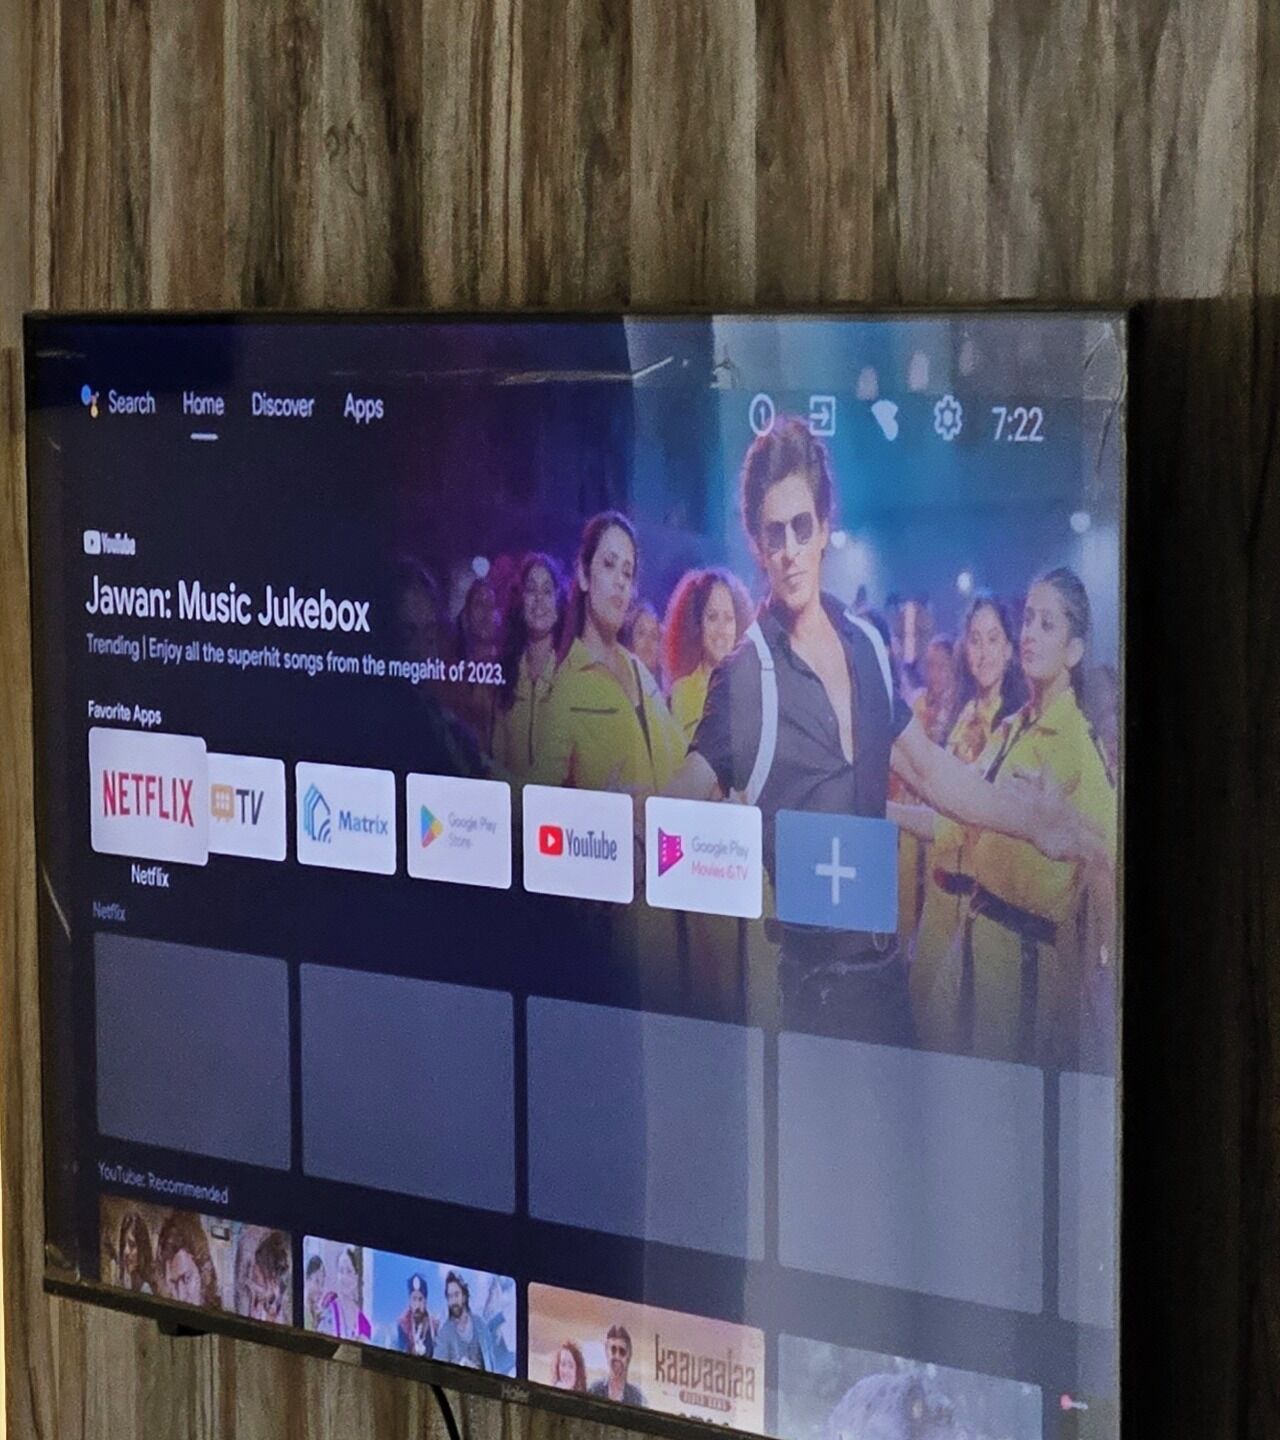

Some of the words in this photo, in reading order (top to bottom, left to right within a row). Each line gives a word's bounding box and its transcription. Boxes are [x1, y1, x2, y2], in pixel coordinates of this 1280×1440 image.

[108, 389, 156, 415] Search
[183, 391, 225, 416] Home
[251, 391, 315, 417] Discover
[343, 392, 384, 424] Apps
[991, 406, 1045, 442] 7:22
[85, 574, 172, 619] Jawan:
[177, 579, 252, 625] Music
[257, 584, 371, 632] Jukebox
[86, 632, 139, 662] Trending
[148, 637, 183, 665] Enjoy
[184, 641, 200, 661] all
[202, 641, 225, 663] the
[227, 645, 281, 671] superhit
[283, 651, 324, 677] songs
[326, 650, 360, 674] from
[361, 653, 386, 677] the
[389, 657, 446, 685] megahit
[448, 659, 465, 682] of
[467, 661, 507, 685] 2023.
[87, 700, 132, 721] Favorite
[133, 703, 162, 728] Apps
[102, 768, 195, 828] NETFLIX
[235, 787, 265, 826] TV
[338, 809, 389, 836] Matrix
[447, 811, 478, 834] Google
[480, 815, 497, 835] Play
[447, 832, 473, 849] Store
[565, 828, 618, 862] YouTube
[691, 835, 728, 859] Google
[729, 839, 750, 862] Play
[131, 863, 170, 888] Netflix
[735, 864, 749, 881] TV
[92, 900, 127, 922] Netflix
[148, 1170, 229, 1204] Recommended
[654, 1333, 756, 1403] kaavaalaa
